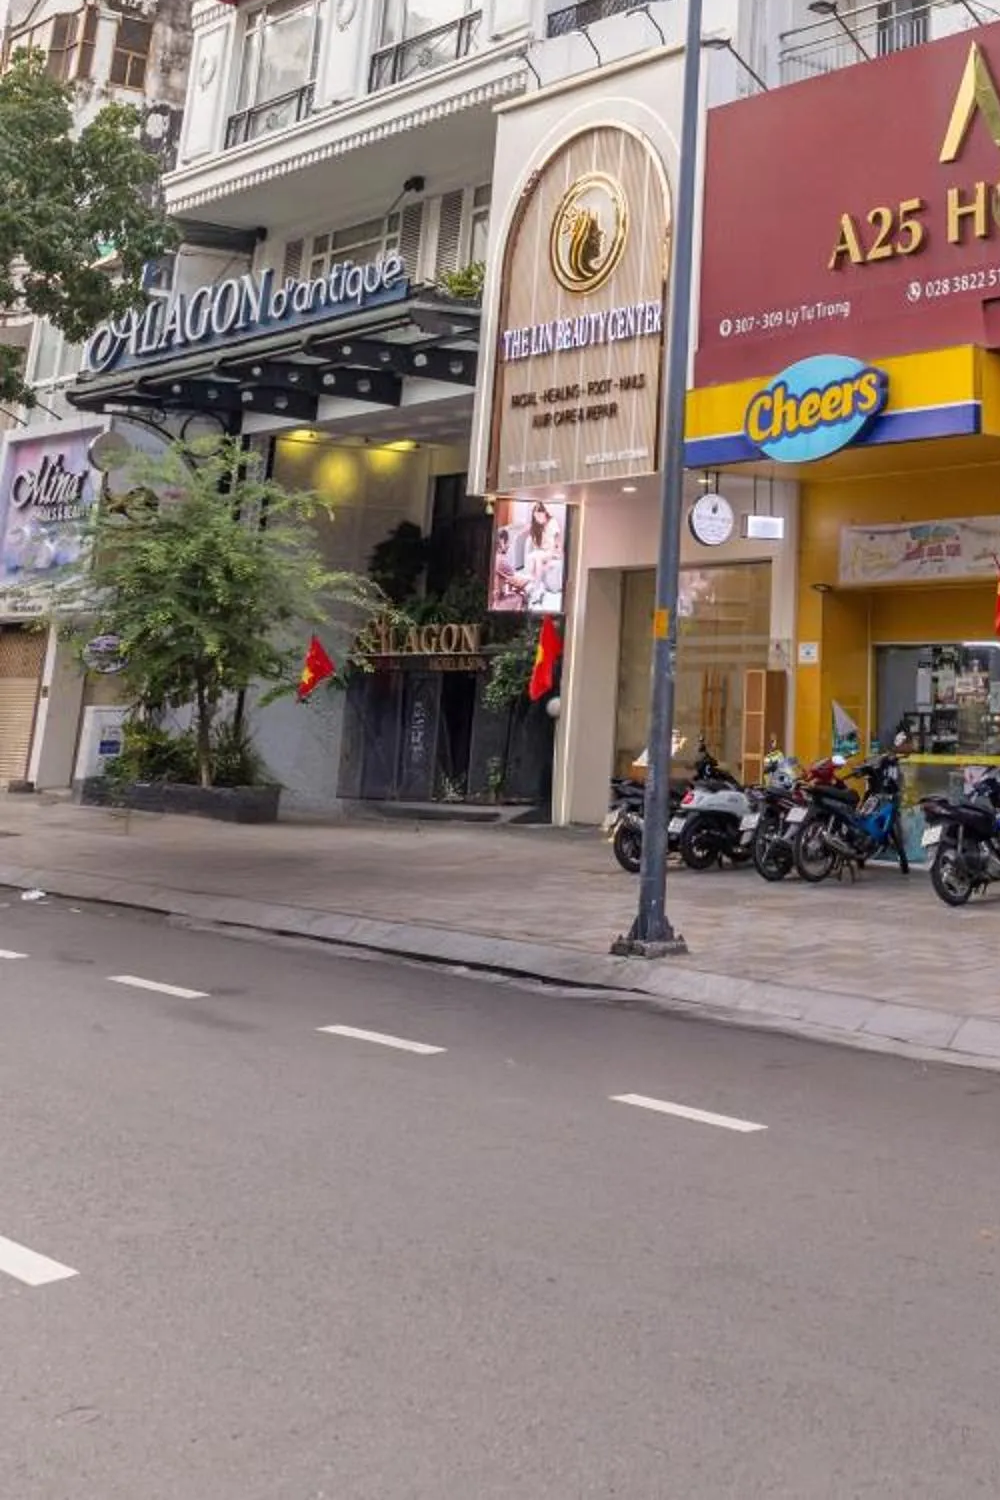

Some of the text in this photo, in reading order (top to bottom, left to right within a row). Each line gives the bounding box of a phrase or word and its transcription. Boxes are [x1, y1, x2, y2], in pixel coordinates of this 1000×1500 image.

[828, 197, 928, 270] A25
[925, 276, 950, 298] 028
[953, 269, 986, 293] 3822
[504, 301, 663, 361] THE LIN BEAUTY CENTER
[747, 373, 878, 442] Cheers
[12, 454, 90, 511] Mina
